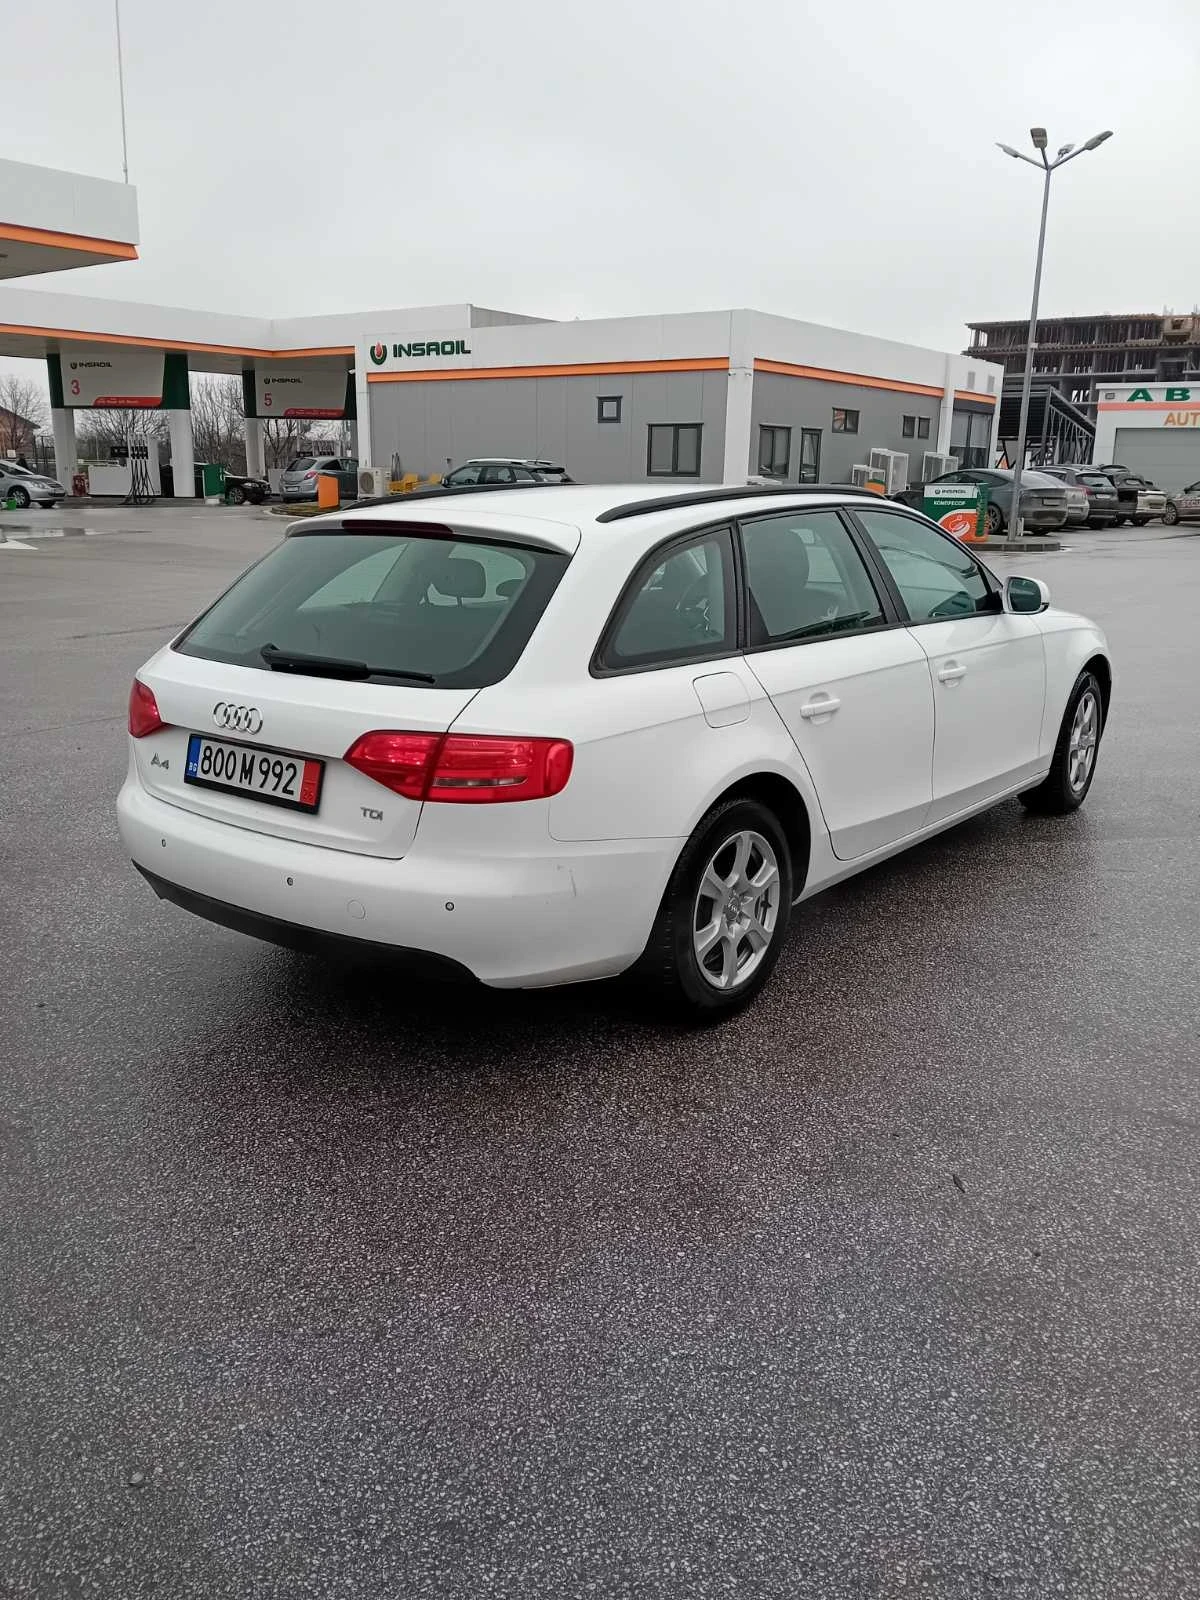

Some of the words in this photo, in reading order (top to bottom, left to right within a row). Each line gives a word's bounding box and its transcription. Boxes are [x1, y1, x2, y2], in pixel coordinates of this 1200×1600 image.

[393, 339, 471, 358] INSAOIL
[71, 379, 80, 395] 3
[264, 393, 273, 406] 5
[150, 752, 170, 770] A4
[189, 762, 198, 772] BG
[360, 806, 384, 821] TDI
